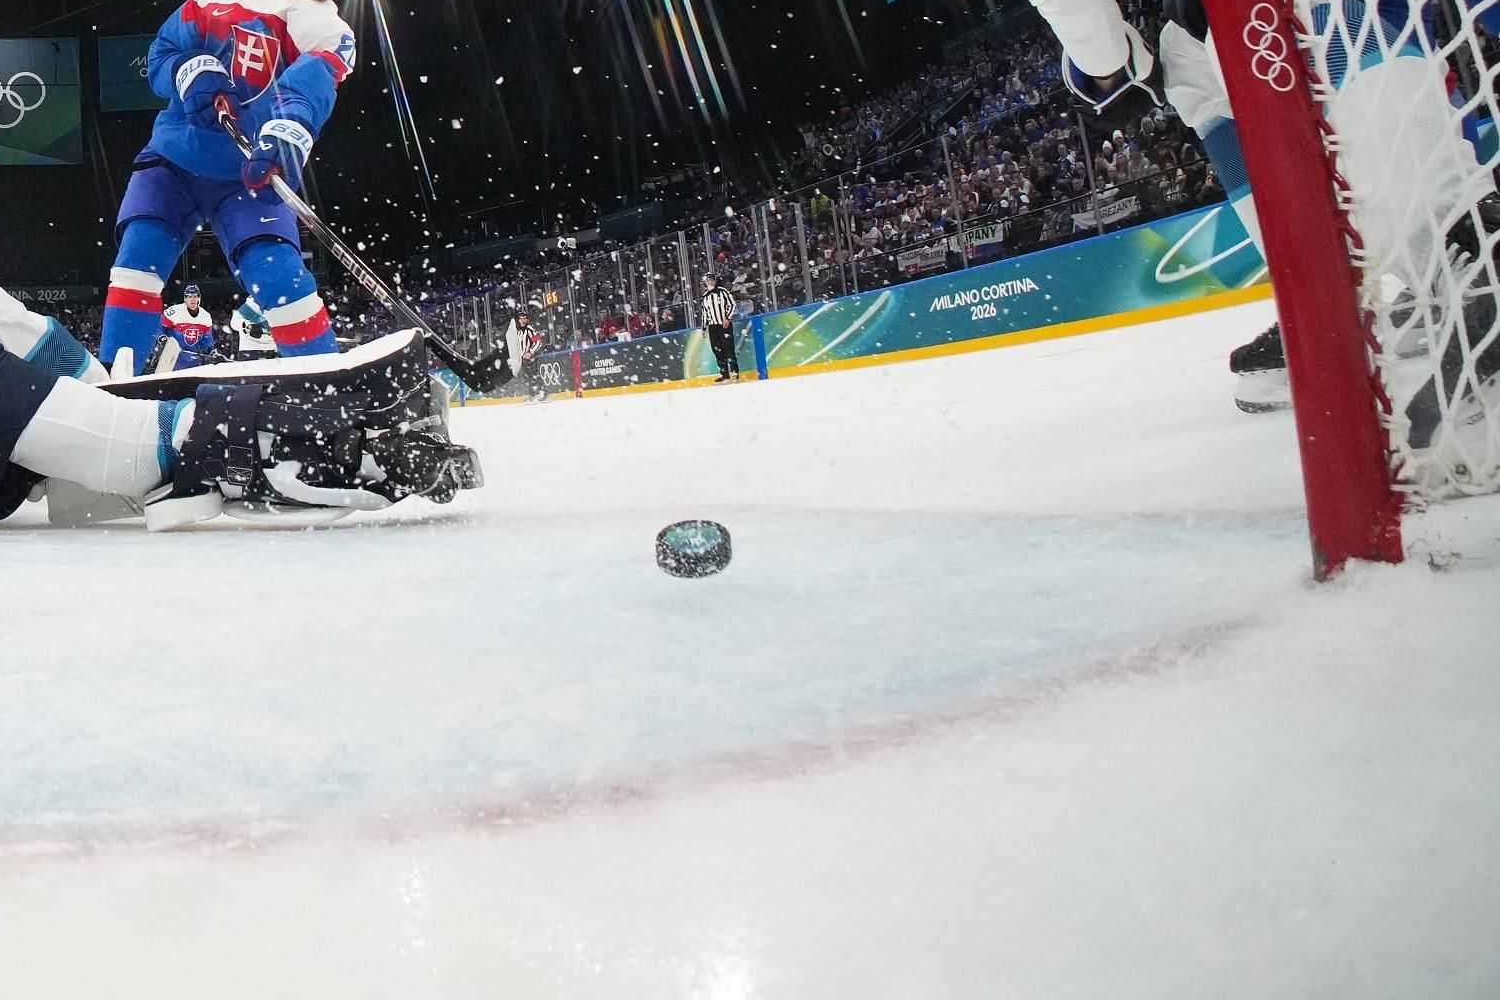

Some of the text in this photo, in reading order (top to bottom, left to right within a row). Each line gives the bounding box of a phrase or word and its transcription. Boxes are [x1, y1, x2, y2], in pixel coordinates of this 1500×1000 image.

[37, 289, 67, 301] 2026
[928, 277, 1040, 313] MILANO CORTINA
[969, 302, 997, 321] 2026
